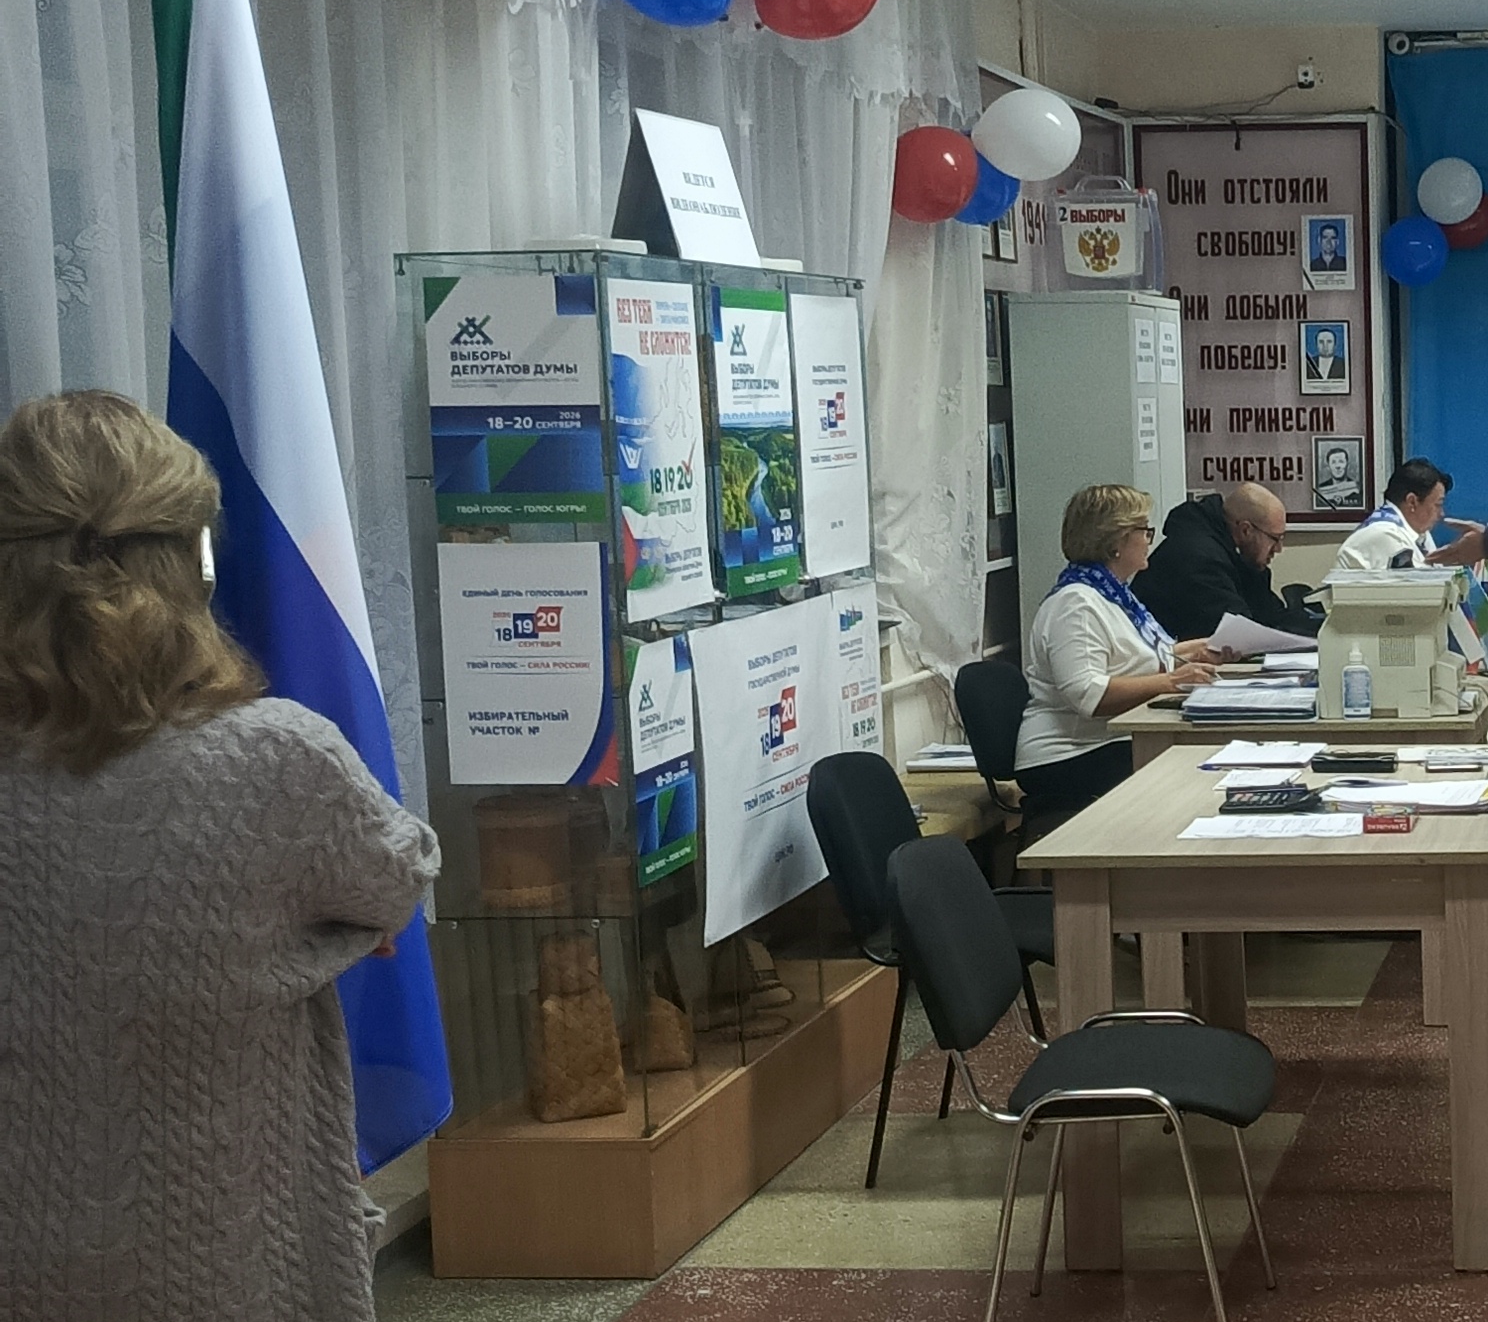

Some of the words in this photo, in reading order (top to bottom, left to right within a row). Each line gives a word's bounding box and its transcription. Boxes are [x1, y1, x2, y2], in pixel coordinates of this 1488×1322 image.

[1058, 207, 1068, 222] 2
[1070, 209, 1126, 223] ВЫБОРЫ
[450, 351, 511, 362] ВЫБОРЫ
[450, 364, 531, 377] ДЕПУТАТОВ
[533, 364, 578, 377] ДУМЫ
[559, 411, 581, 420] 2026
[535, 421, 582, 429] СЕНТЯБРЯ
[456, 504, 480, 514] ТВОЙ
[482, 505, 513, 514] ГОЛОС
[523, 505, 554, 514] ГОЛОС
[462, 589, 499, 598] ЕДИНЫЙ
[501, 590, 523, 598] ДЕНЬ
[525, 590, 588, 598] ГОЛОСОВАНИЯ
[494, 628, 513, 642] 18
[515, 619, 534, 634] 19
[536, 612, 558, 627] 20
[466, 661, 489, 669] ТВОЙ
[468, 710, 569, 721] ИЗБИРАТЕЛЬНЫЙ
[469, 726, 524, 736] УЧАСТОК
[760, 732, 770, 758] 18
[771, 713, 781, 739] 19
[781, 696, 795, 723] 20
